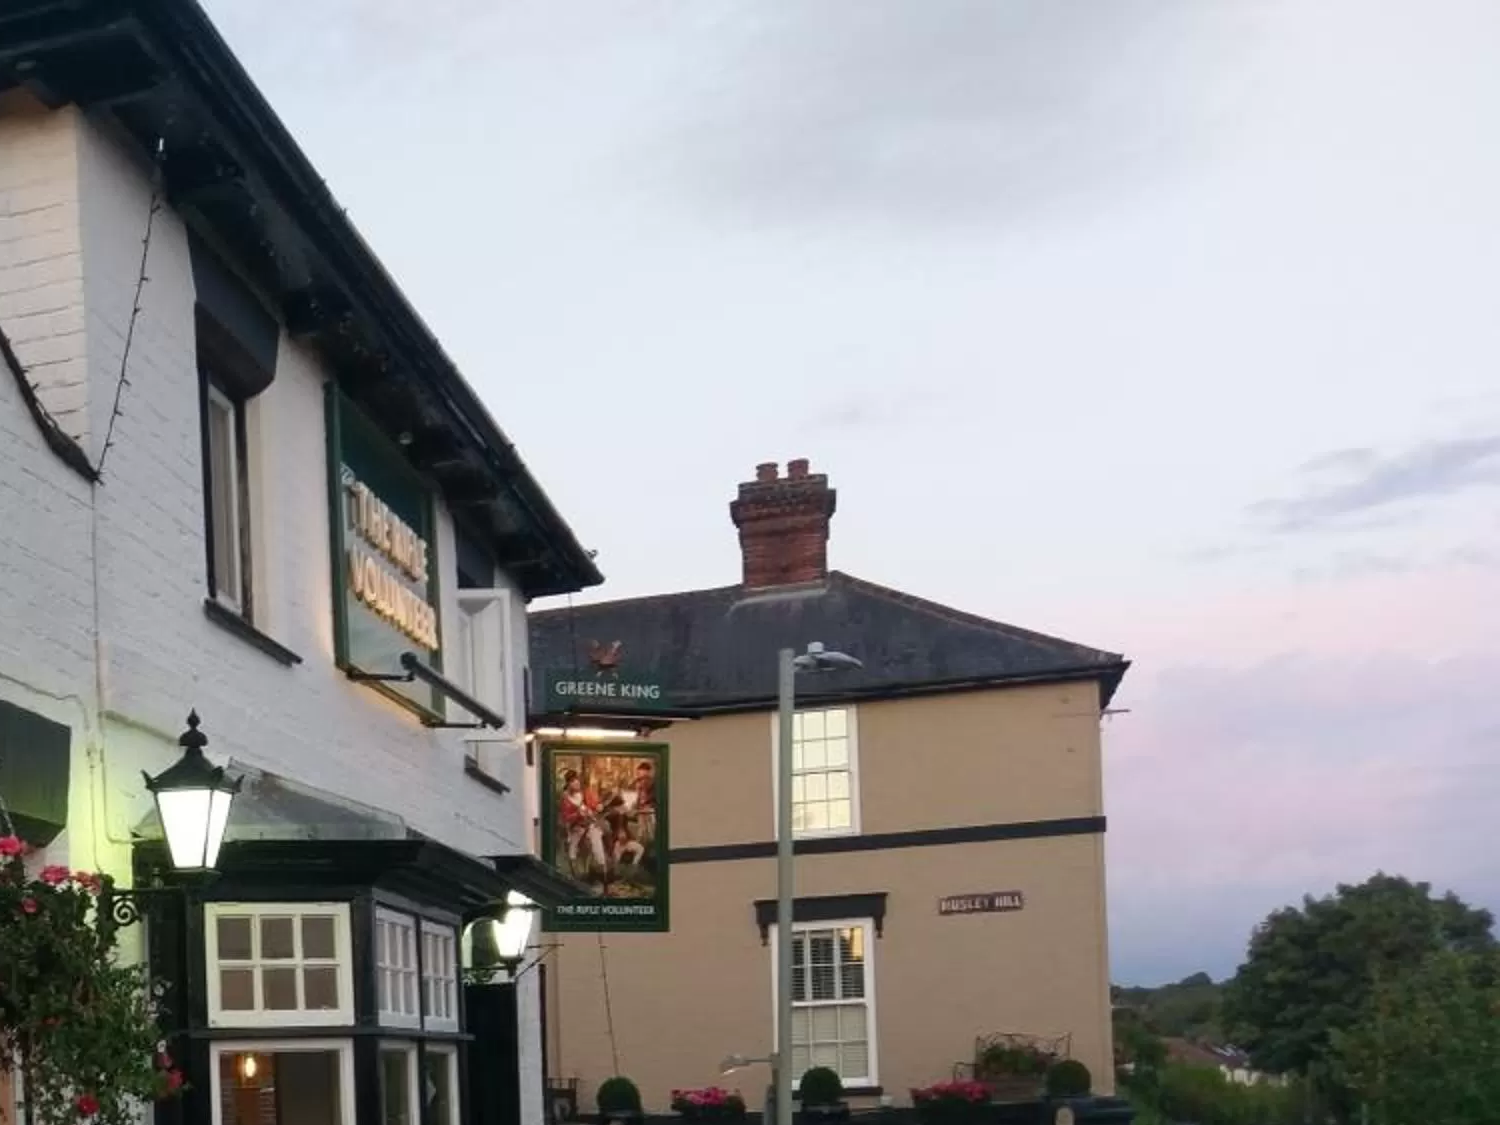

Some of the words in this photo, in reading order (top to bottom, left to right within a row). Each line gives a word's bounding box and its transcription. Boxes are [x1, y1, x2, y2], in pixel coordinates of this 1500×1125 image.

[555, 681, 616, 697] GREENE
[621, 683, 660, 699] KING
[556, 904, 575, 915] THE
[575, 904, 600, 915] RIFLE
[602, 905, 655, 916] VOLUNTEER
